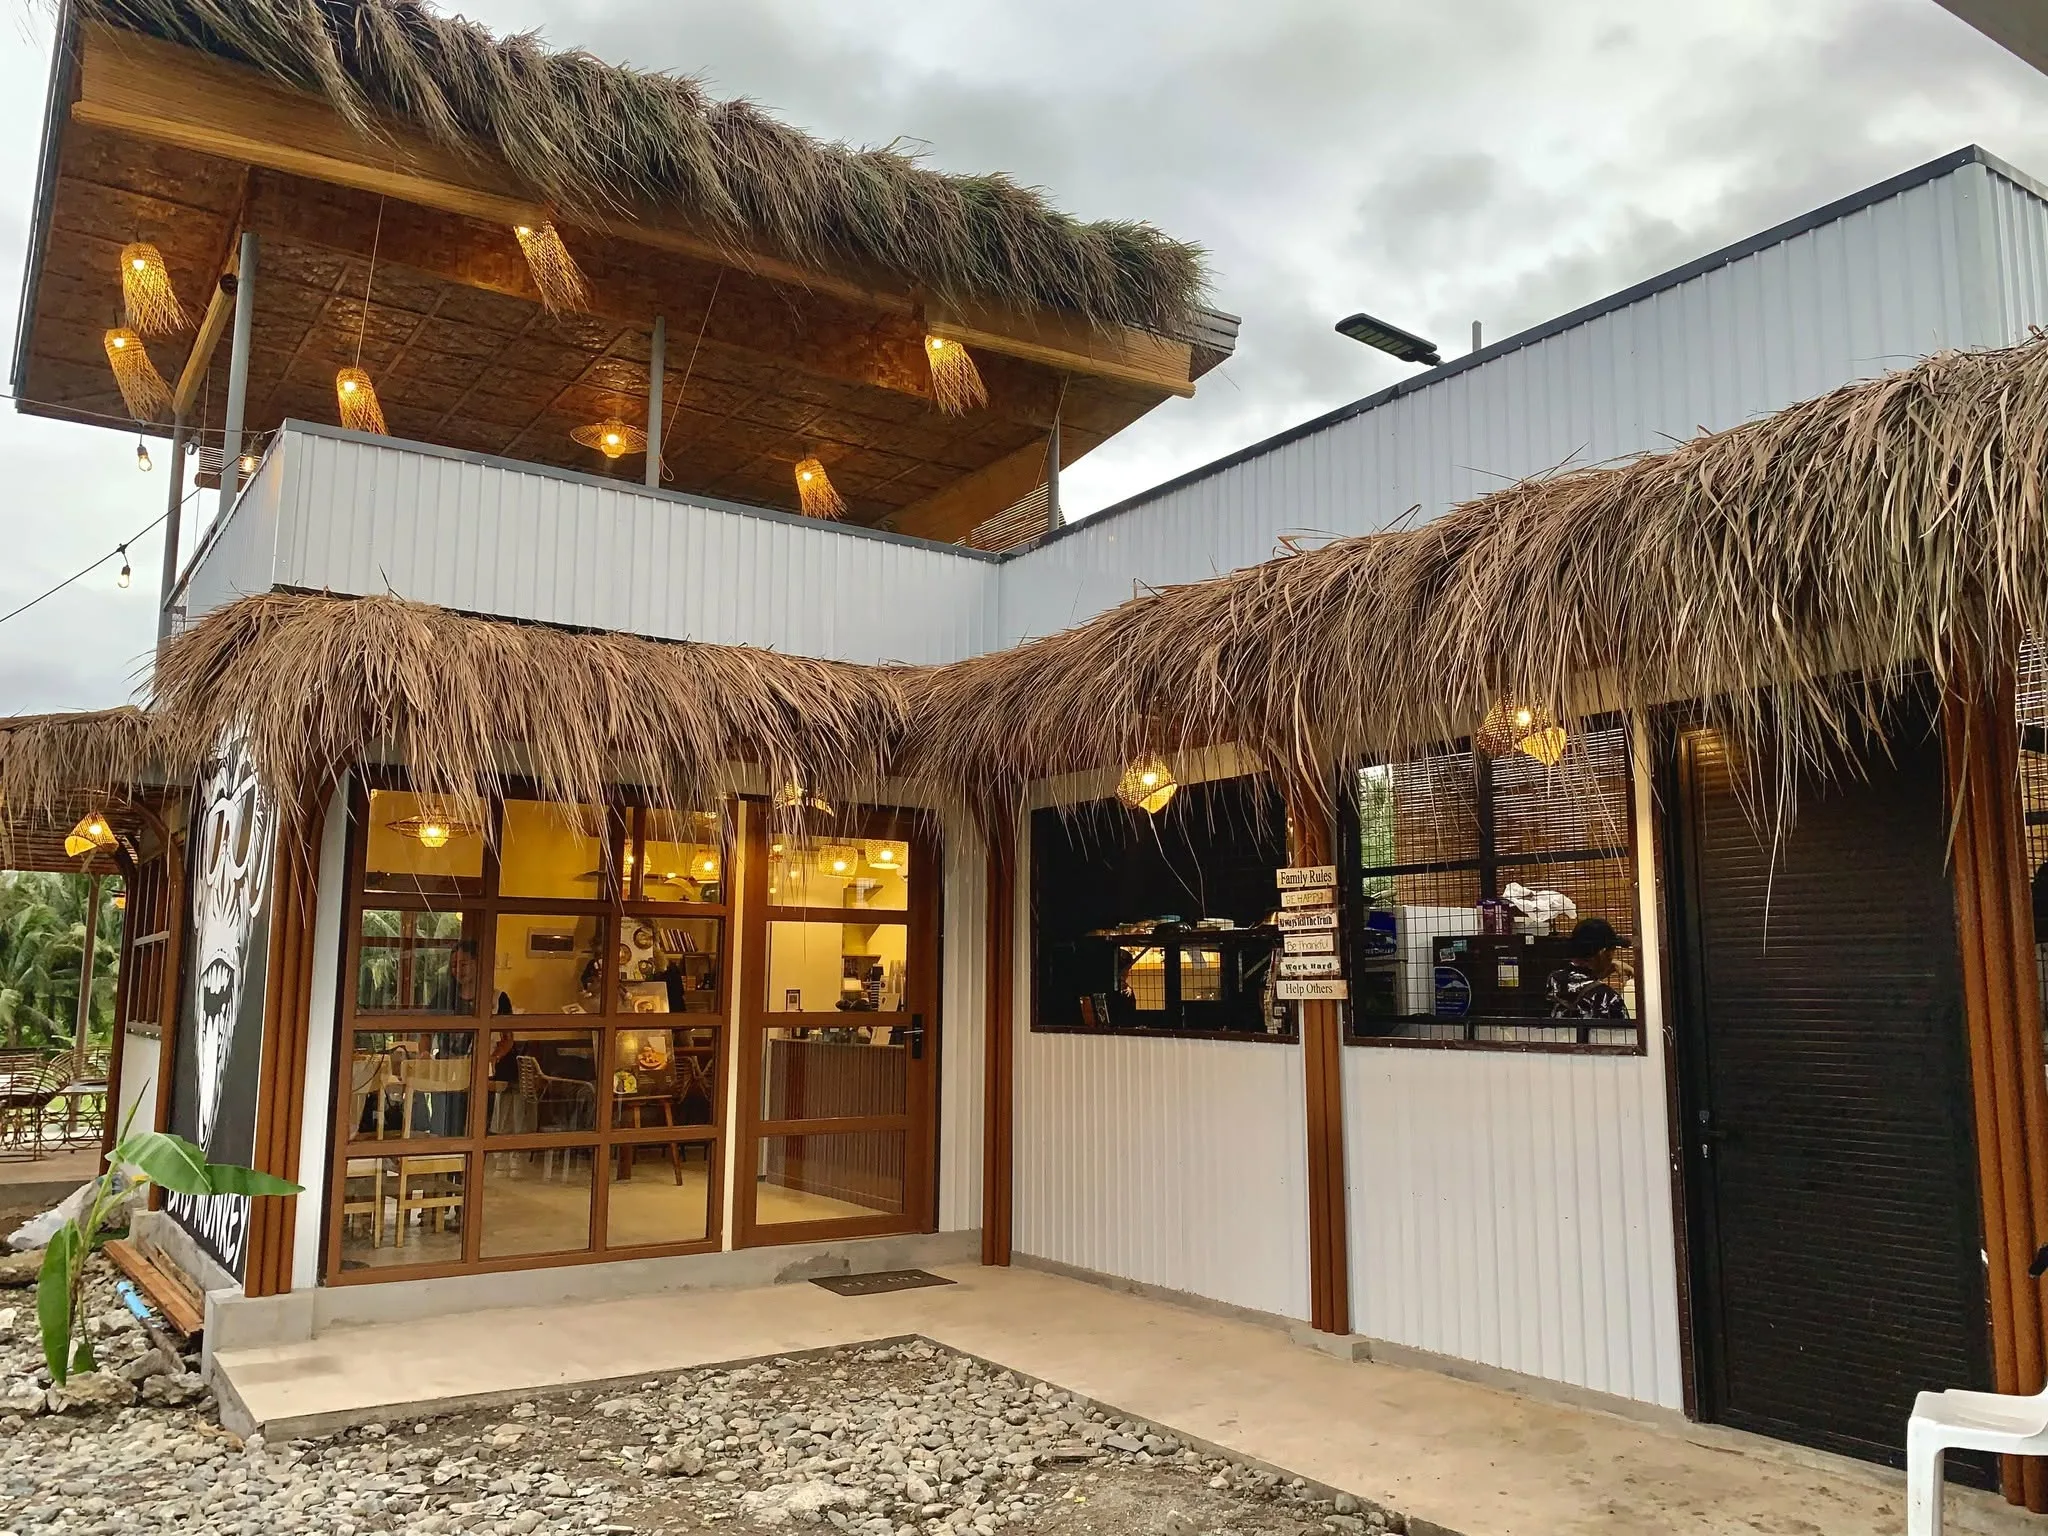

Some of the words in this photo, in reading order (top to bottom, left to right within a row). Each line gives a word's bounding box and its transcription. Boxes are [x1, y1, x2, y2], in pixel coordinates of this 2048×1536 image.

[1281, 871, 1307, 887] Family
[1309, 869, 1332, 883] Rules
[1285, 894, 1296, 904] BE
[1279, 918, 1297, 928] Always
[1298, 917, 1306, 926] Tell
[1307, 916, 1316, 926] The
[1317, 915, 1333, 925] Truth
[1286, 941, 1296, 951] Be
[1299, 938, 1329, 950] Thankful
[1285, 963, 1308, 971] Work
[1285, 983, 1305, 996] Help
[1306, 983, 1333, 994] Others
